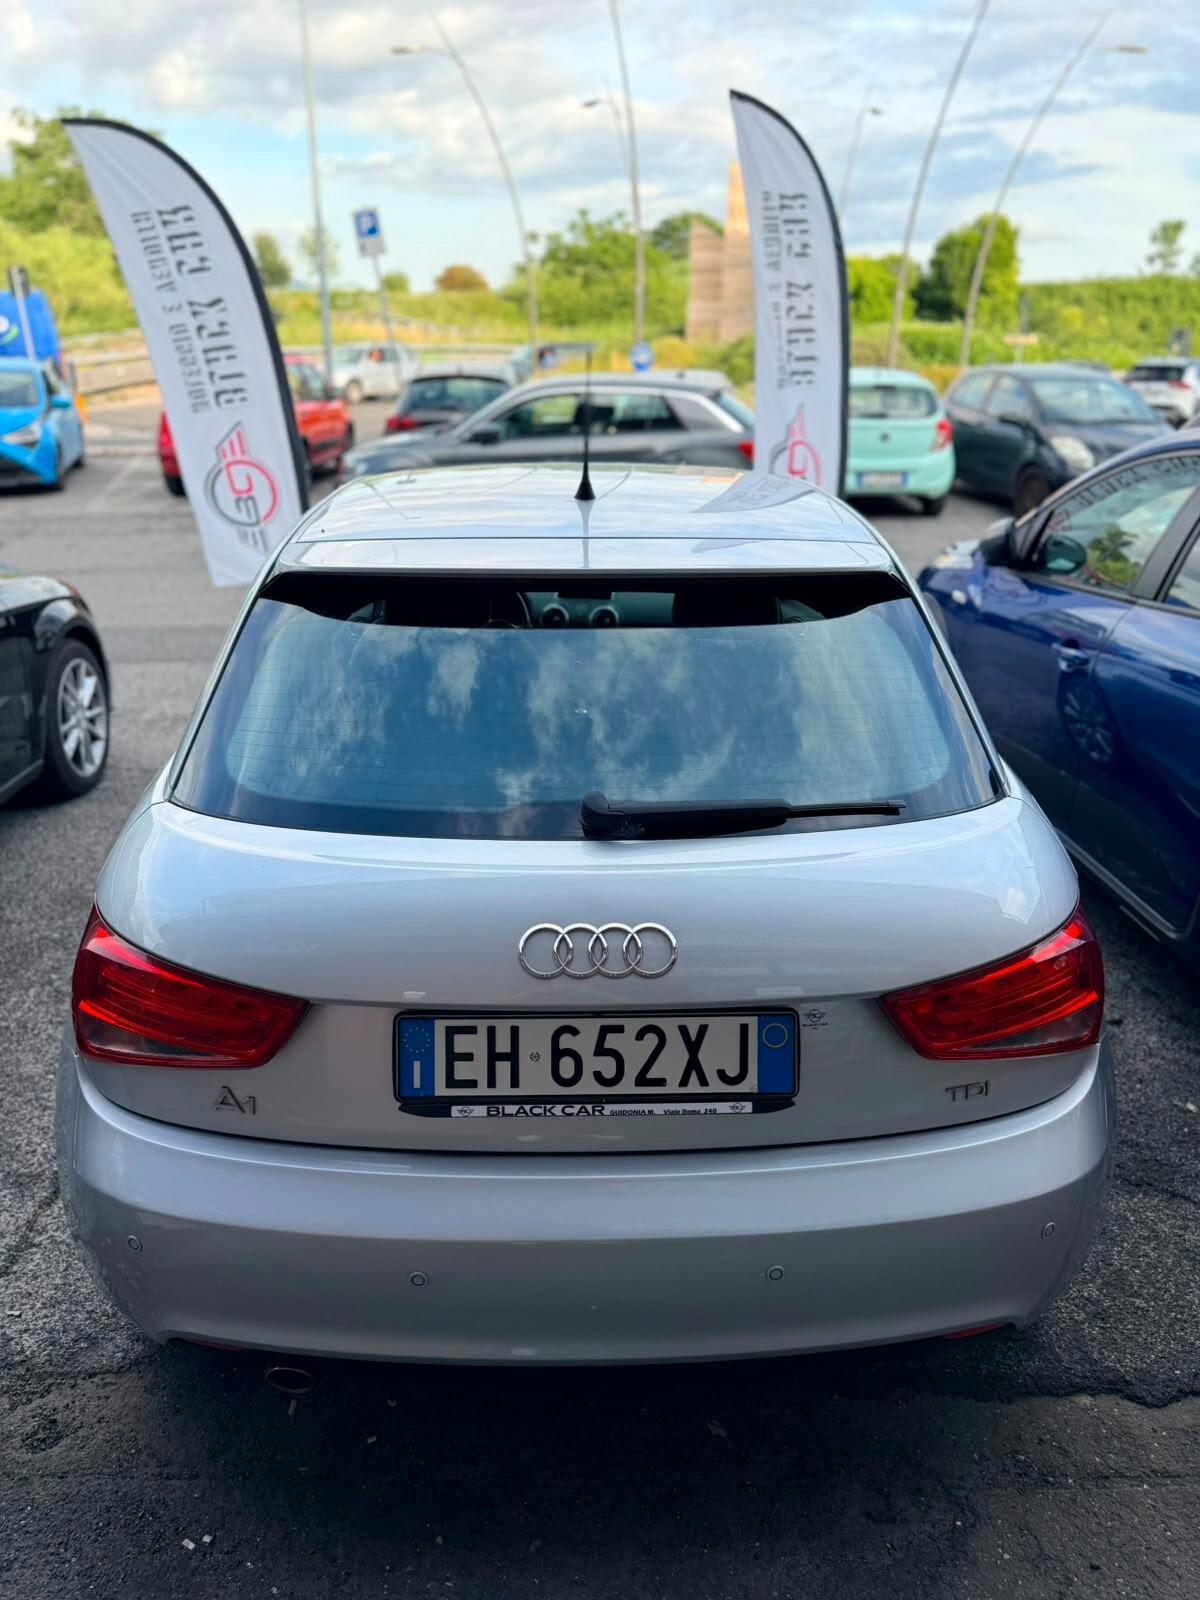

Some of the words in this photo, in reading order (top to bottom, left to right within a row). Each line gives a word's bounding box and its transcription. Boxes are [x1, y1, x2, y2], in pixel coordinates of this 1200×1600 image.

[413, 1060, 421, 1089] I
[445, 1025, 520, 1089] EH
[550, 1023, 749, 1088] 652XJ
[213, 1085, 257, 1117] A1
[944, 1080, 990, 1103] TDI
[486, 1105, 557, 1117] BLACK
[560, 1105, 605, 1116] CAR
